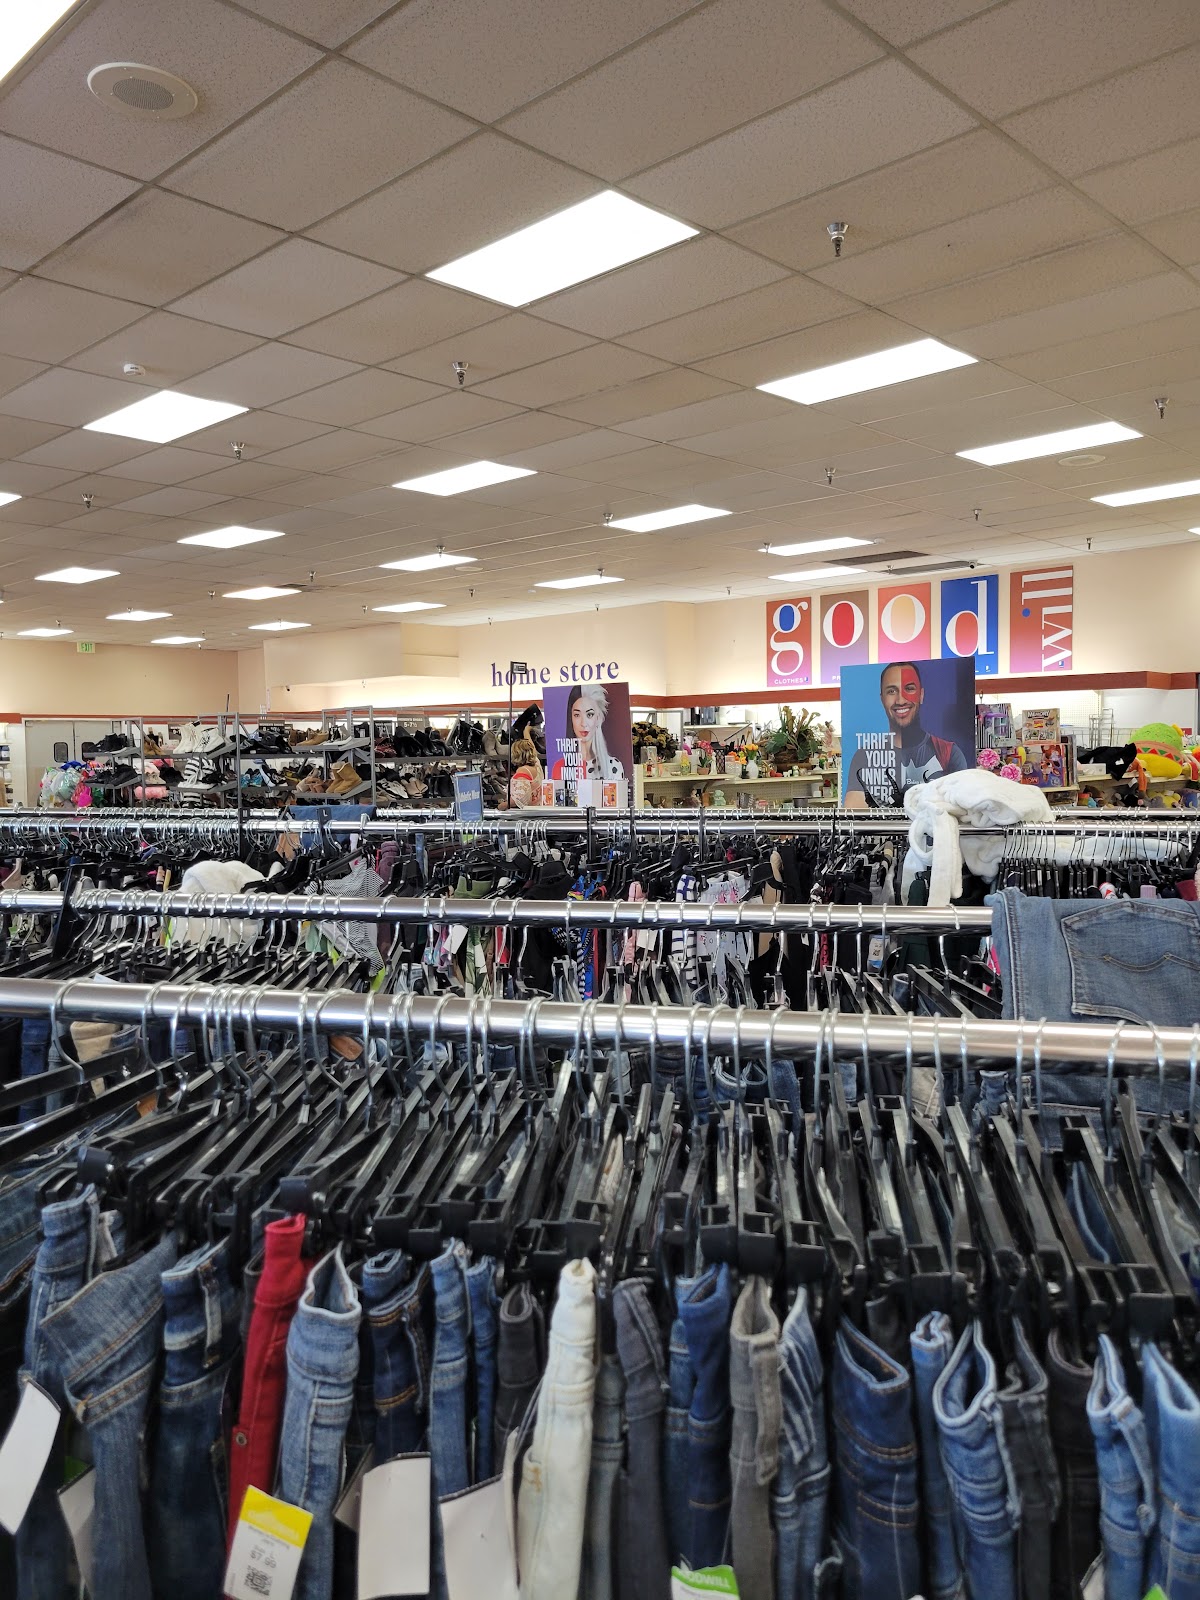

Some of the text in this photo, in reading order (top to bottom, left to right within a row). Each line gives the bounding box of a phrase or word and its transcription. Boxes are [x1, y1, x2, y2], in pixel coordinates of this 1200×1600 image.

[81, 643, 93, 652] EXIT
[491, 660, 619, 687] home store
[774, 677, 804, 685] CLOTHES
[556, 738, 582, 752] THRIFT
[856, 732, 896, 749] THRIFT
[563, 753, 583, 766] YOUR
[866, 751, 896, 767] YOUR
[561, 767, 584, 780] INNER
[862, 768, 896, 785] INNER
[323, 809, 328, 817] L
